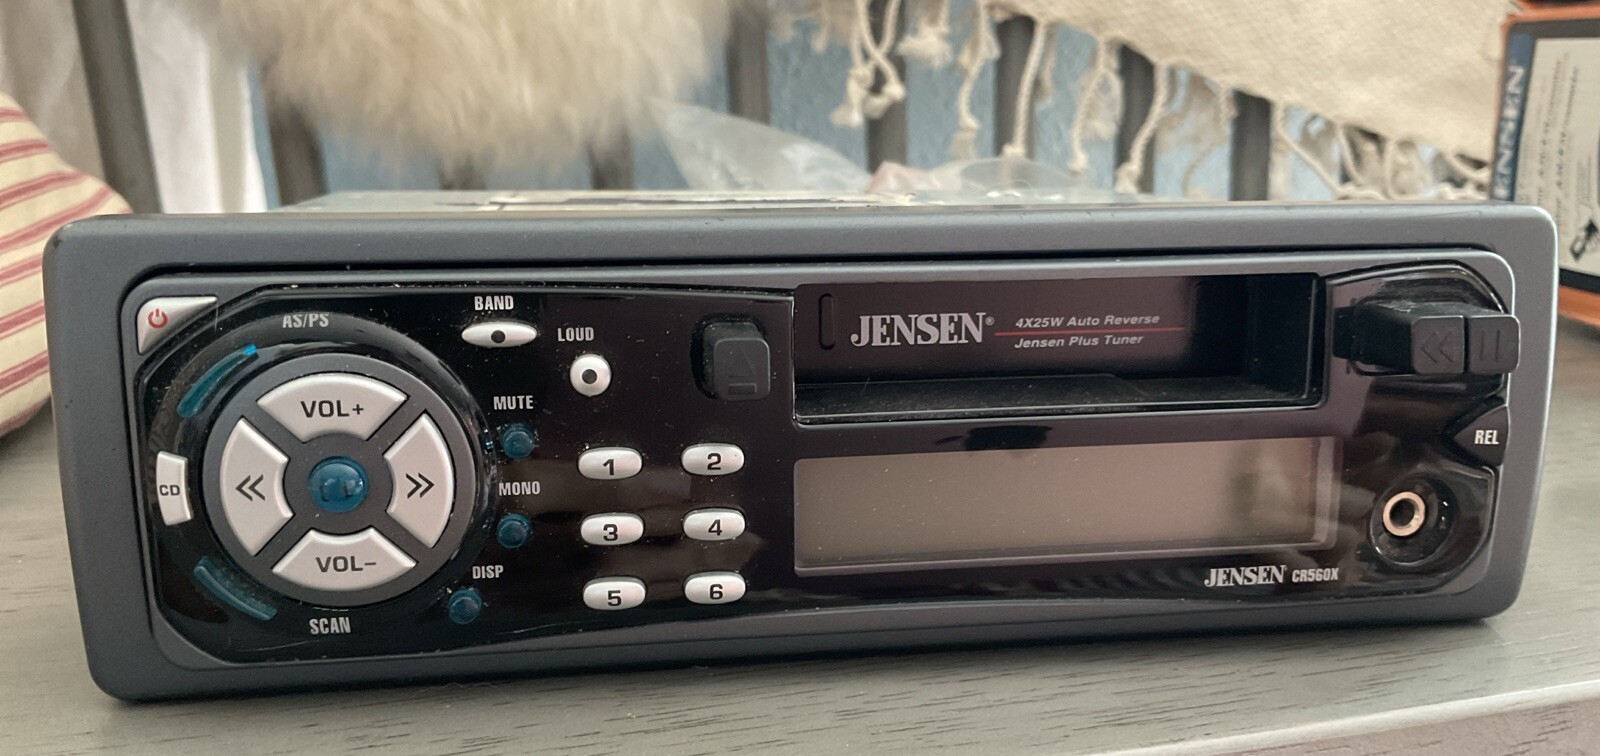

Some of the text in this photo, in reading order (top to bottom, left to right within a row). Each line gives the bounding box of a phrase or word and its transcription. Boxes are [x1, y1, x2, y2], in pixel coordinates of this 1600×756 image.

[474, 295, 514, 311] BAND
[282, 312, 330, 329] AS/PS
[1015, 314, 1161, 329] 4X25W Auto Reverse
[557, 327, 594, 342] LOUD
[1014, 334, 1144, 349] Jensen Plus Tuner
[493, 395, 534, 411] MUTE
[1474, 429, 1499, 446] REL
[602, 458, 616, 476] 1
[706, 452, 722, 471] 2
[159, 484, 181, 497] CD
[498, 481, 541, 496] MONO
[602, 523, 619, 542] 3
[707, 518, 723, 537] 4
[472, 565, 504, 580] DISP
[1204, 564, 1340, 587] JENSEN CR560X
[607, 589, 623, 607] 5
[708, 583, 724, 601] 6
[309, 616, 351, 635] SCAN
